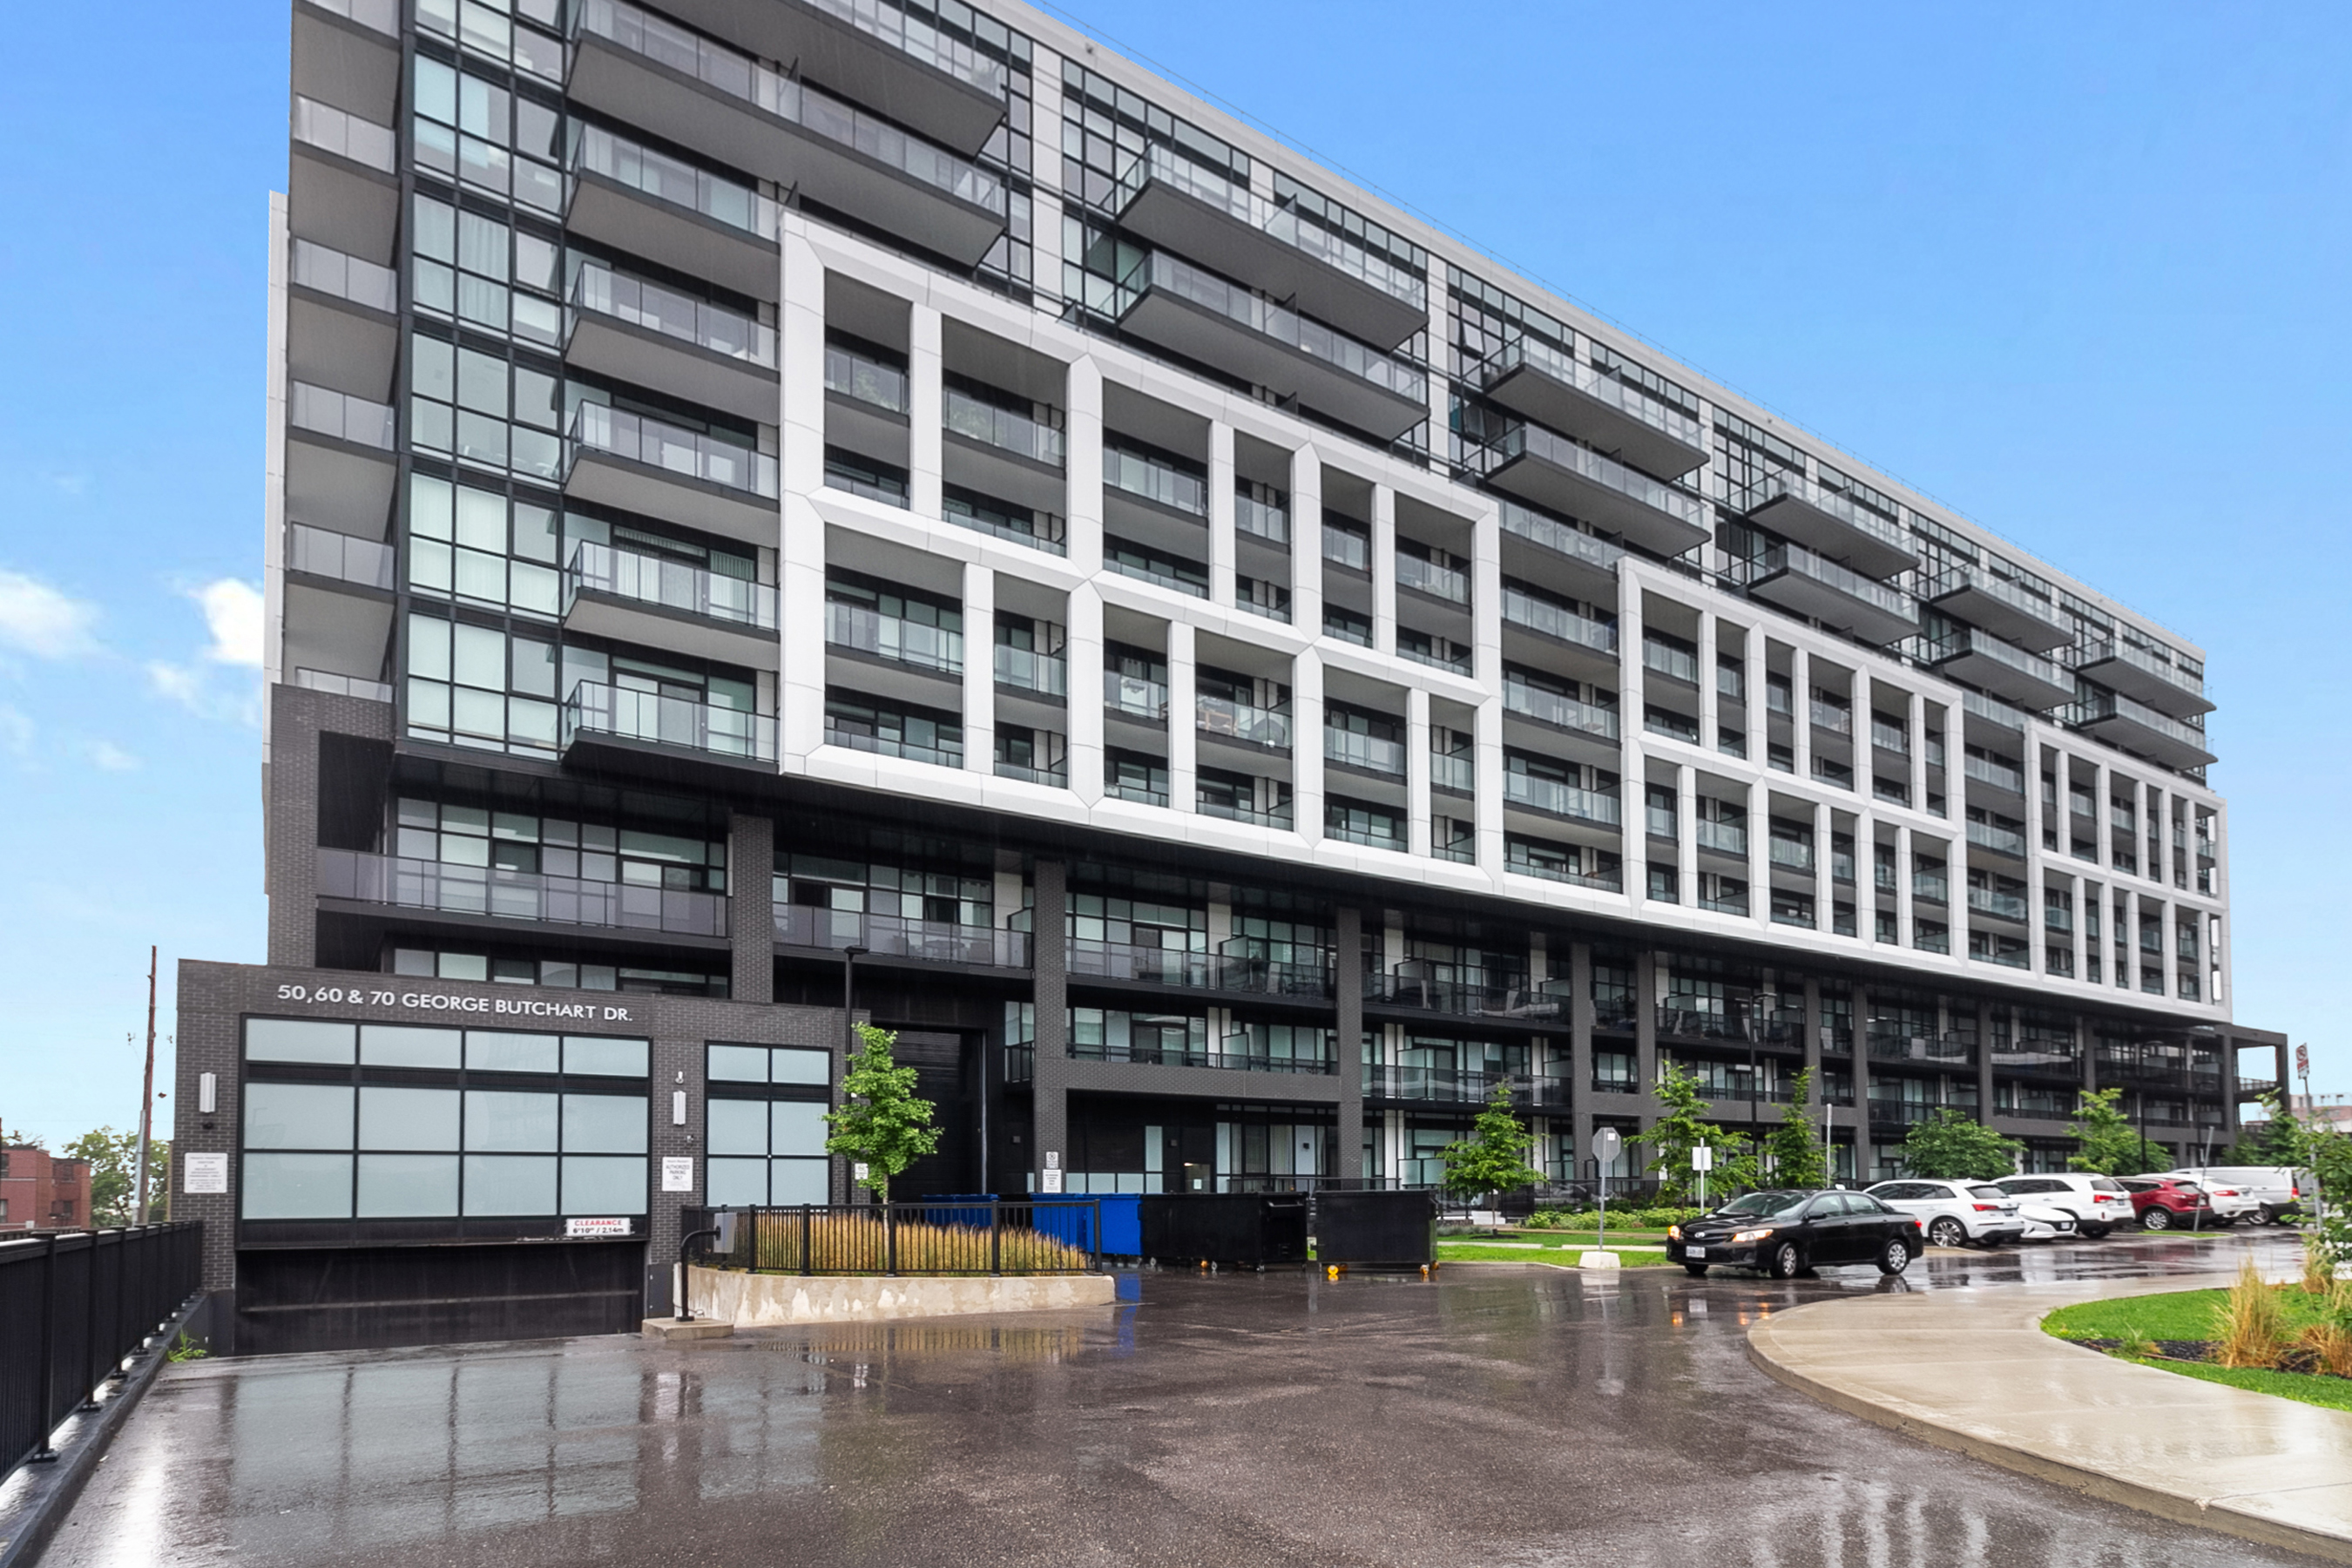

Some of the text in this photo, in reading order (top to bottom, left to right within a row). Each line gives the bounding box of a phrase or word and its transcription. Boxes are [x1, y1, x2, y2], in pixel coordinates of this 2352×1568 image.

[347, 989, 364, 1004] &
[369, 990, 395, 1006] 70
[402, 992, 490, 1012] GEORGE
[495, 998, 597, 1019] BUTCHART
[604, 1006, 633, 1022] DR.
